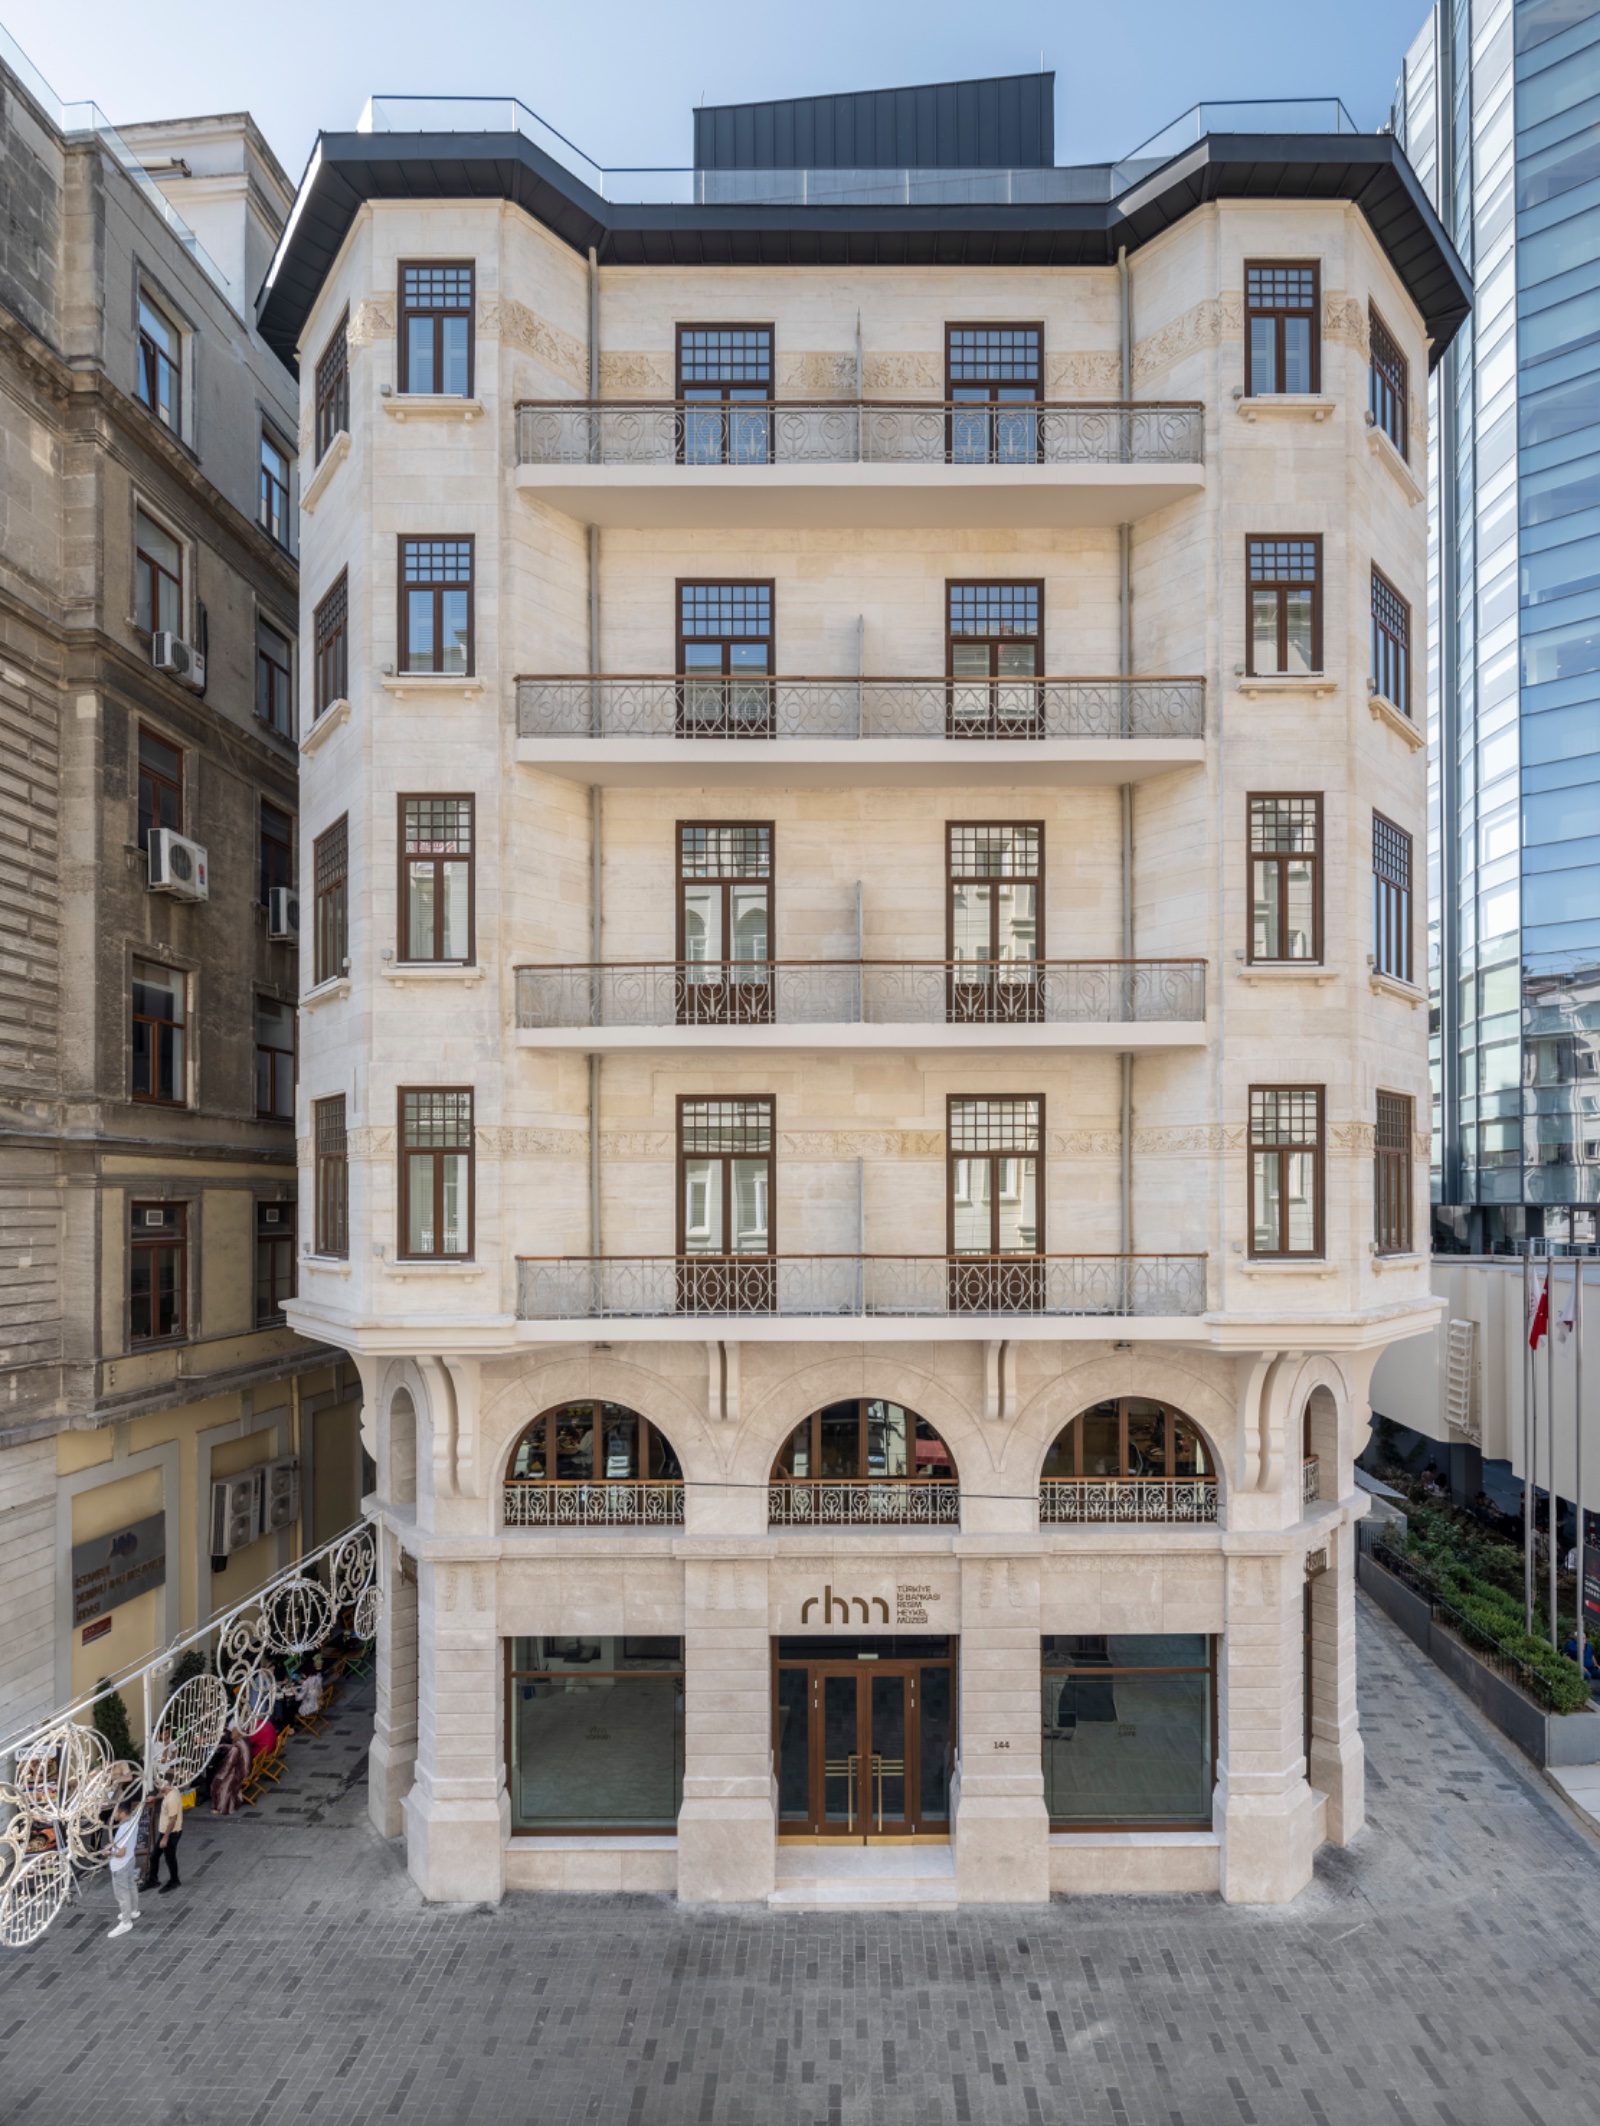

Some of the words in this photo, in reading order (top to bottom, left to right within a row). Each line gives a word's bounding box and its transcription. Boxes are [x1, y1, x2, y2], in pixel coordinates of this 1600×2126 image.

[897, 1585, 931, 1593] TÜRKİYE
[905, 1593, 941, 1601] BANKASI
[801, 1585, 889, 1624] rhm
[993, 1740, 1010, 1750] 144
